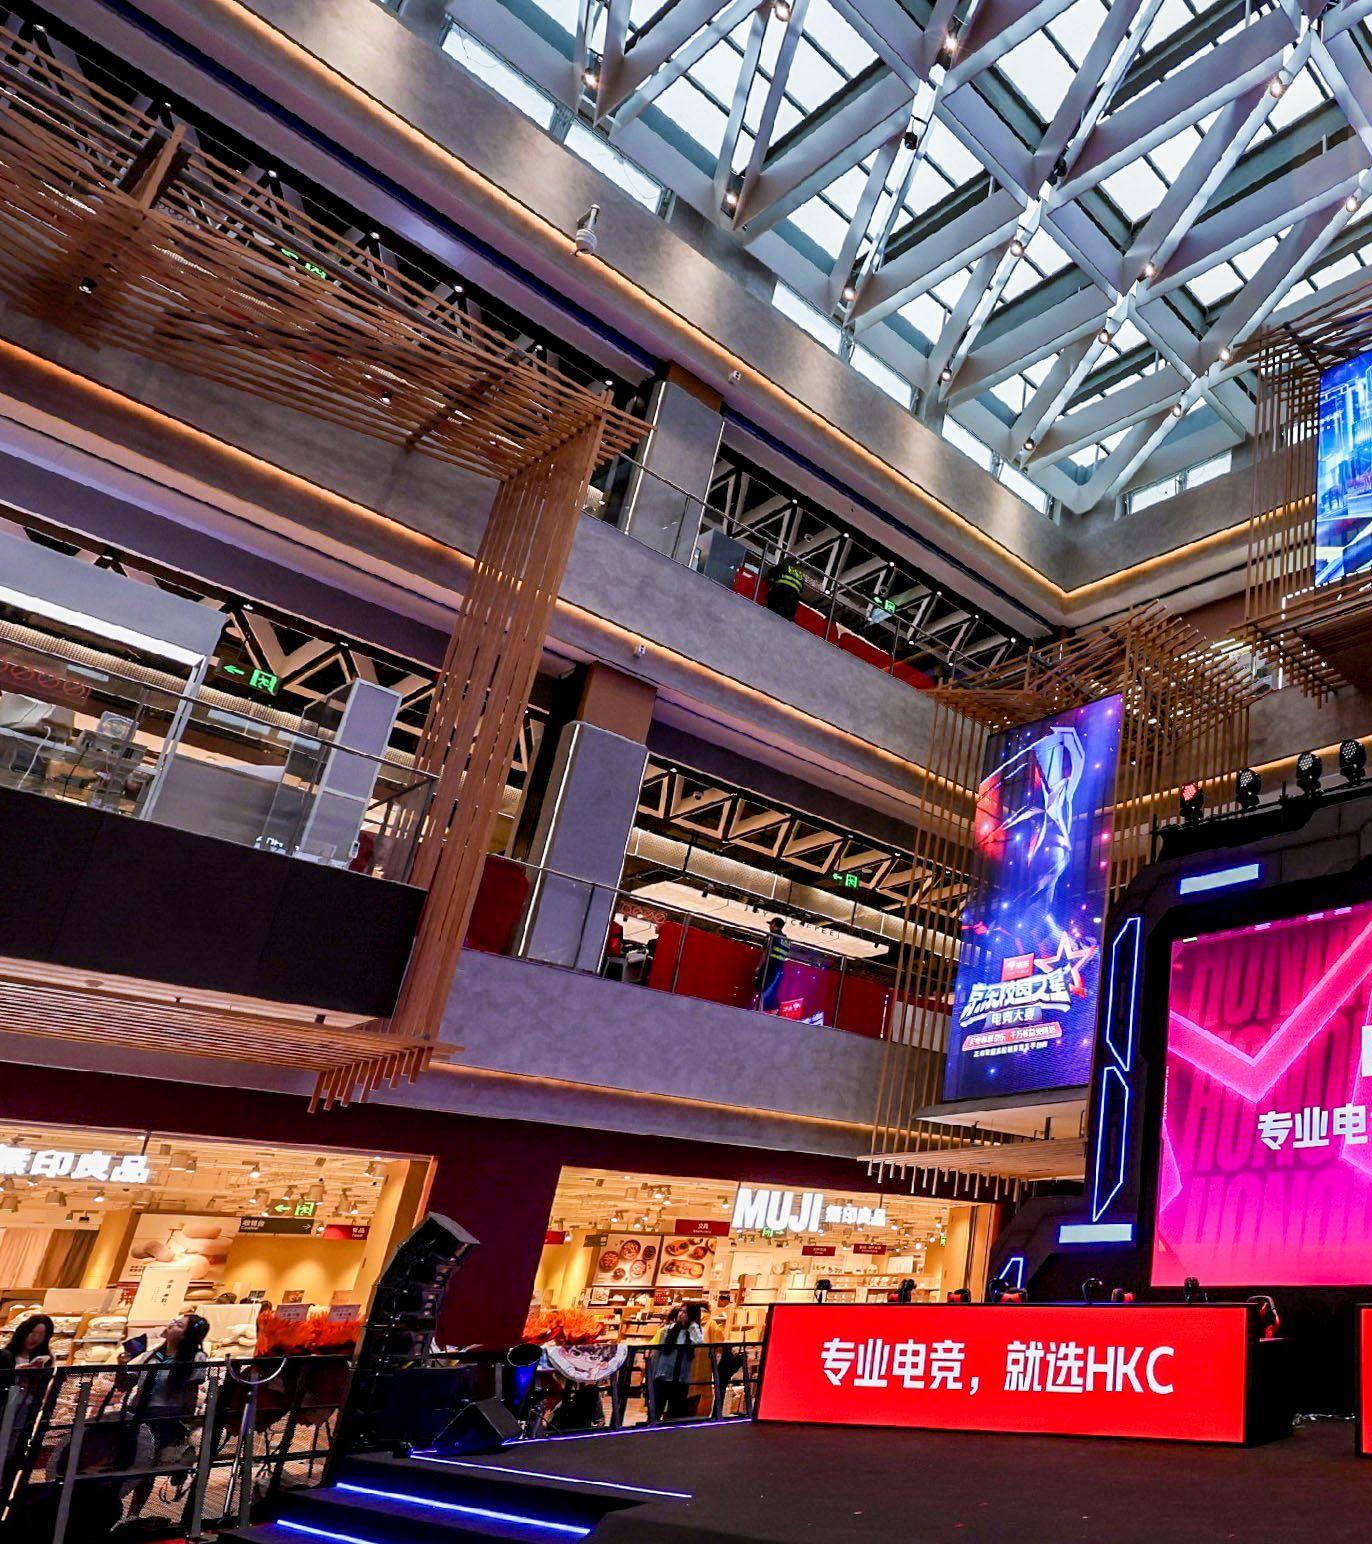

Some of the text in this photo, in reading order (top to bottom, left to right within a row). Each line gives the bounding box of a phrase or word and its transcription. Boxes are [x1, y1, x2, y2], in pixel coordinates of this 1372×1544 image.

[960, 966, 1071, 1021] 京东校园之星
[732, 1187, 824, 1233] MUJI
[820, 1337, 1175, 1397] 专业电竞，就选HKC
